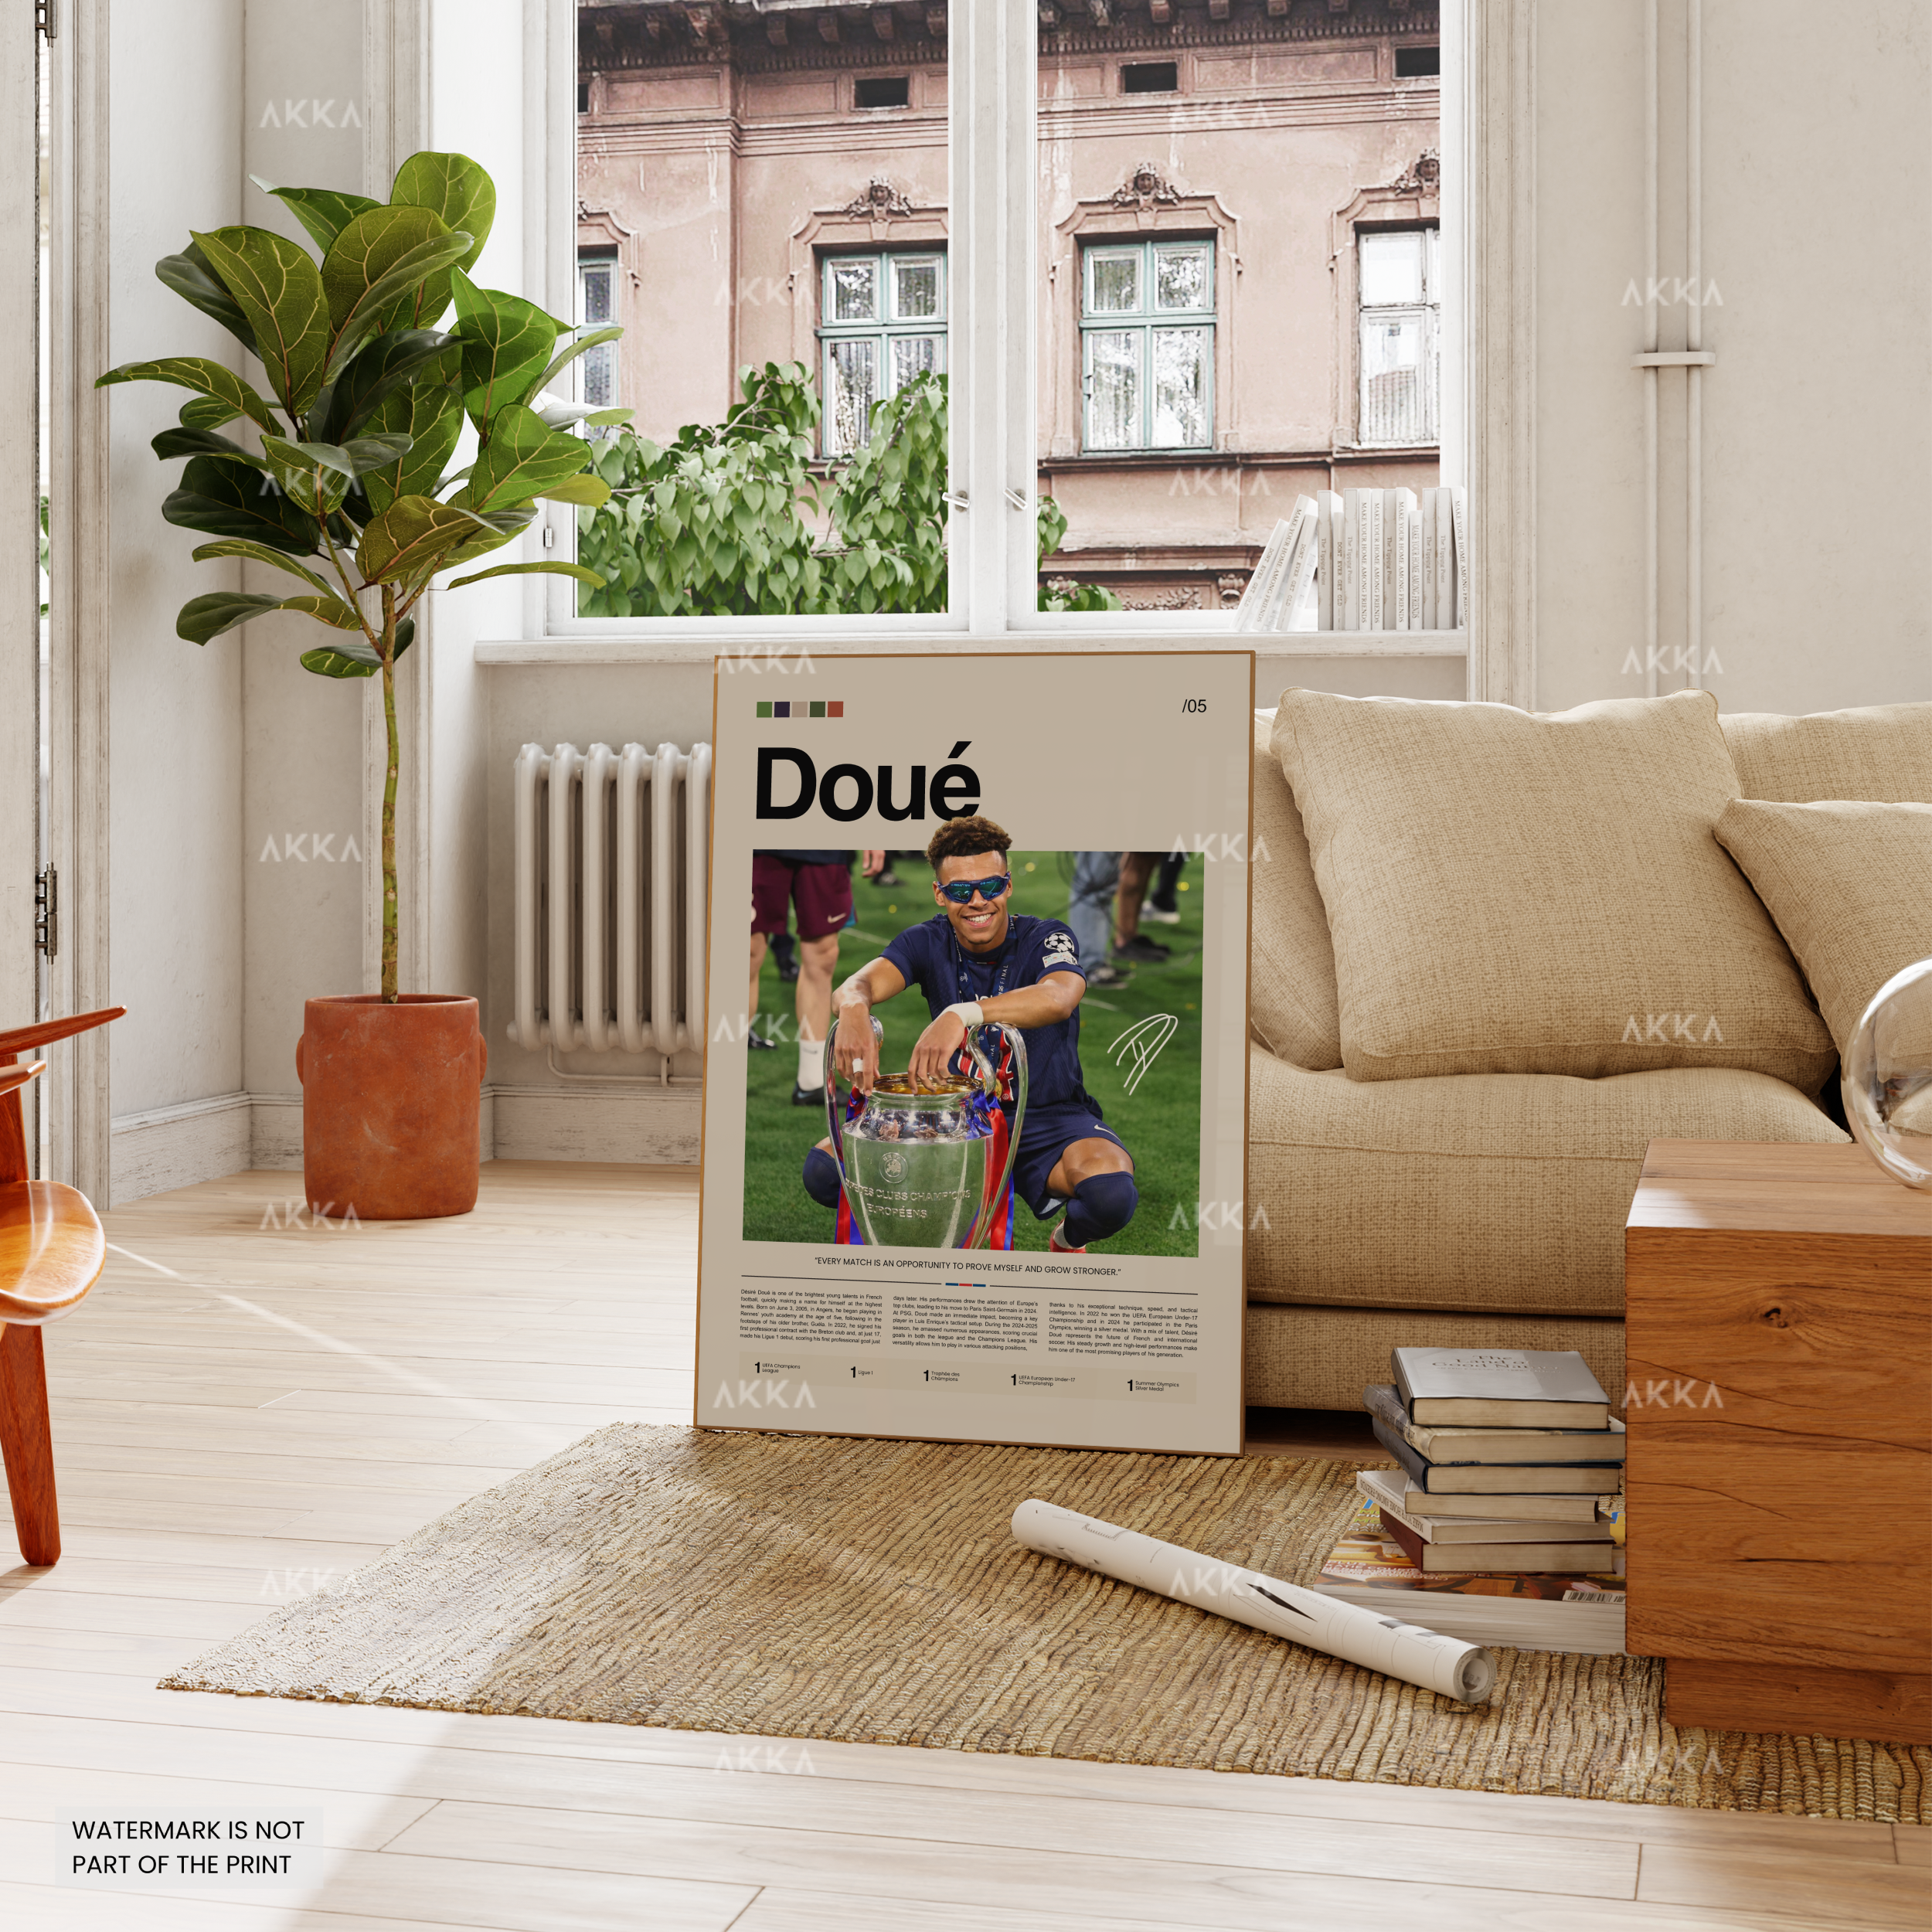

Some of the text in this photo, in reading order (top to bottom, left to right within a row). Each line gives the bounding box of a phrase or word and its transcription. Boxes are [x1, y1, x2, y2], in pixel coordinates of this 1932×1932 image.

[1298, 543, 1307, 560] DONT
[1257, 508, 1302, 622] MAKE YOUR HOME AMONG FRIENDS
[1293, 562, 1301, 577] EVER
[1182, 699, 1206, 713] /05
[756, 741, 981, 821] Doué
[876, 1189, 908, 1201] CLUBS
[866, 1202, 927, 1219] EUROPÉENS
[896, 1260, 951, 1269] OPPORTUNITY
[965, 1263, 992, 1271] PROVE
[994, 1264, 1023, 1272] MYSELF
[1044, 1266, 1071, 1274] GROW
[754, 1362, 760, 1374] 1
[850, 1366, 856, 1379] 1
[923, 1369, 929, 1382] 1
[1011, 1373, 1016, 1386] 1
[1127, 1379, 1133, 1392] 1
